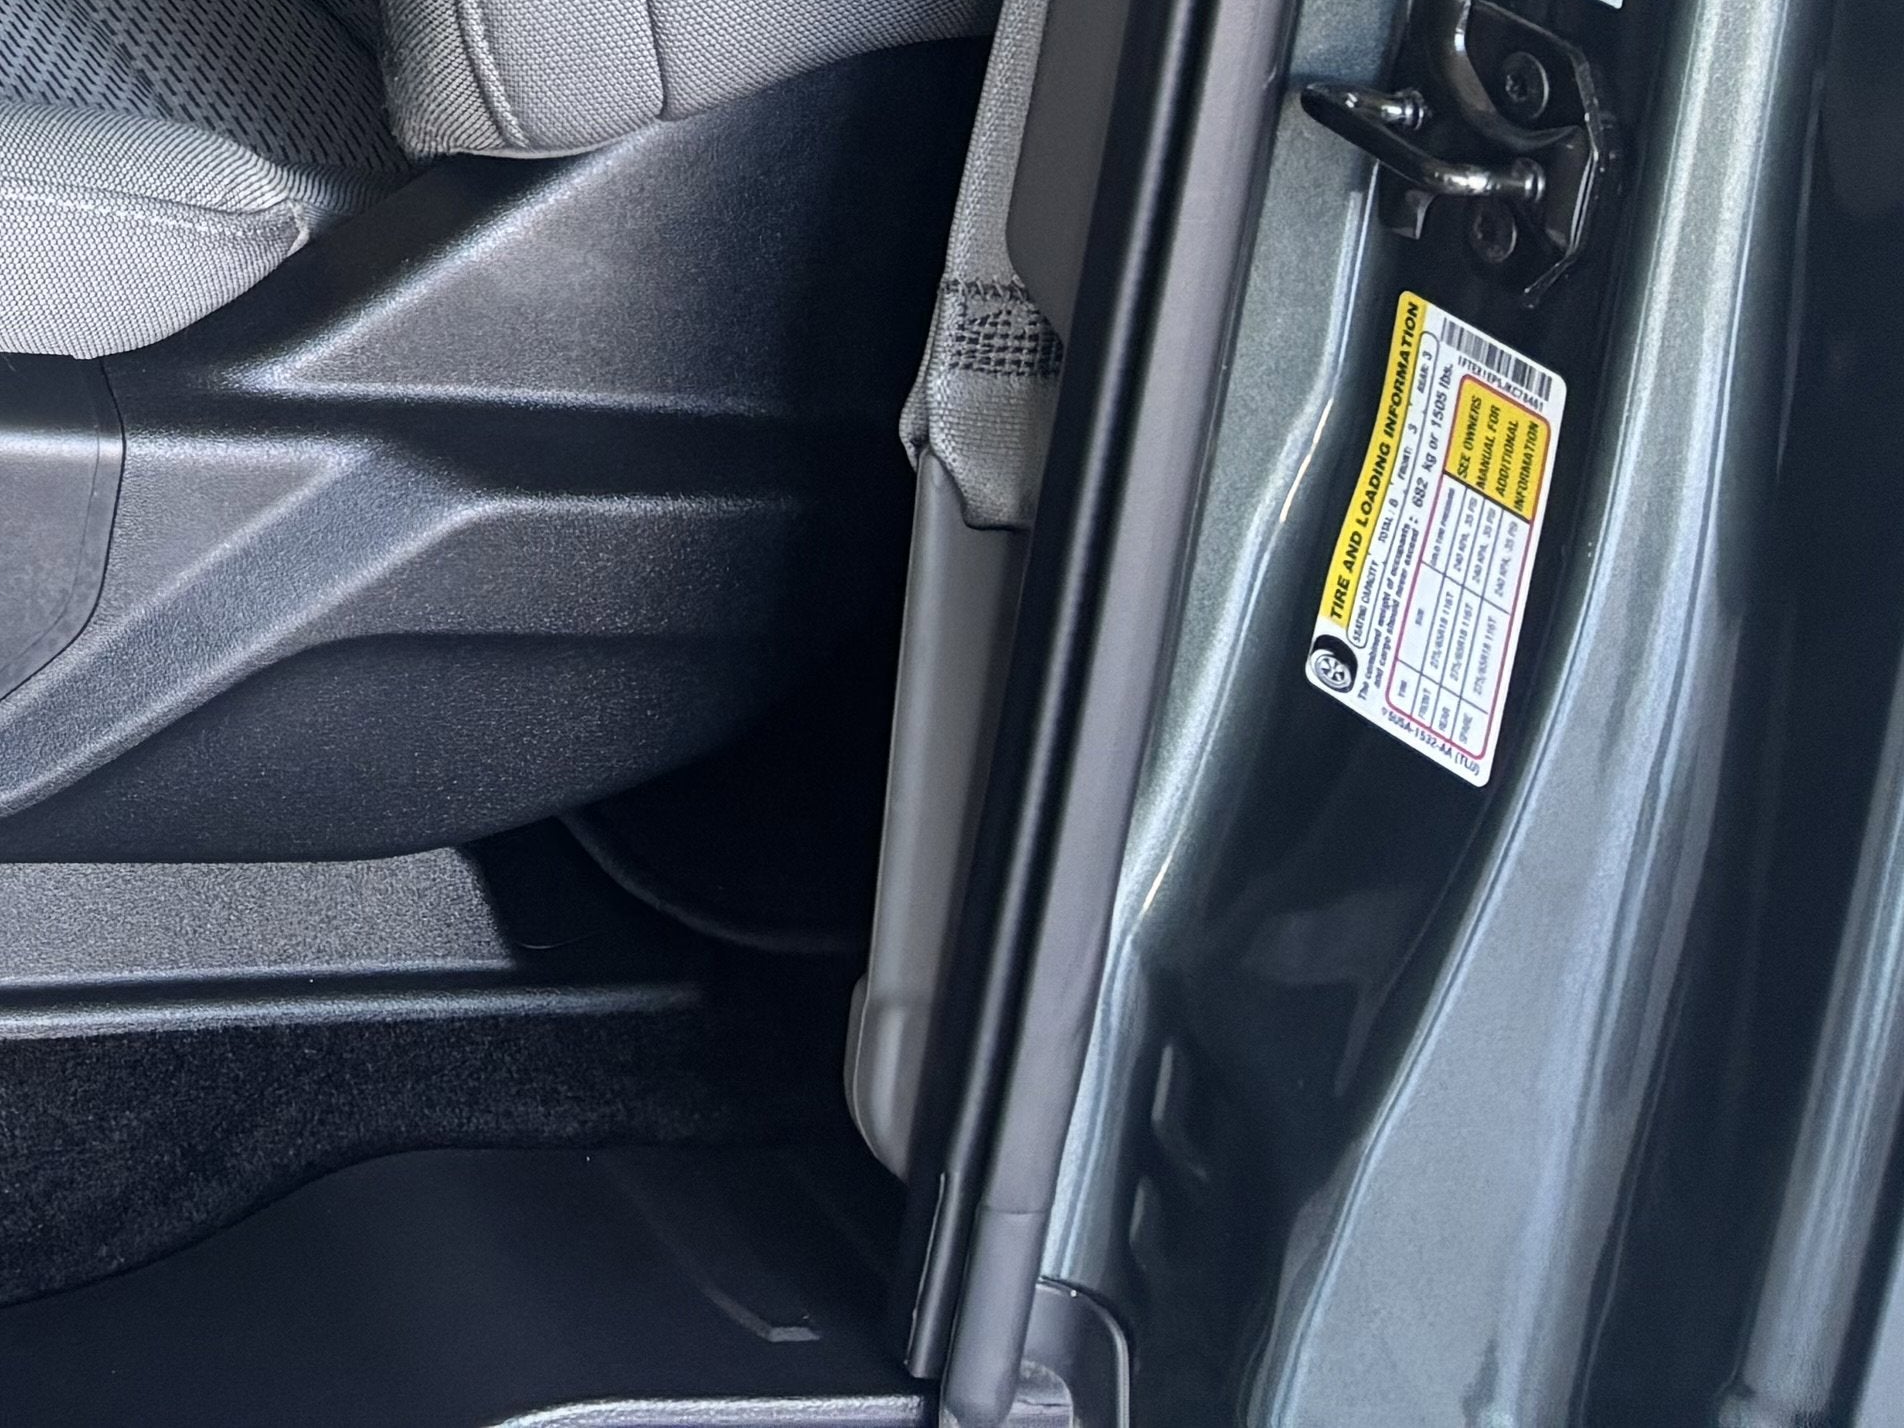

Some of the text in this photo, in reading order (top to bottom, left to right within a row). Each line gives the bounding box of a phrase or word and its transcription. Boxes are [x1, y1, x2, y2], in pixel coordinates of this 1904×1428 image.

[1329, 300, 1418, 621] TIRE AND LOADING INFORMATION
[1412, 359, 1453, 509] 682 kg or 1505 lbs.
[1456, 393, 1482, 479] SEE OWNERS
[1474, 404, 1501, 490] MANUAL FOR
[1494, 416, 1519, 497] ADDITIONAL
[1510, 419, 1540, 512] INFORMATION
[1358, 520, 1410, 701] The combined weight of occupants
[1385, 598, 1400, 635] should
[1395, 566, 1408, 598] never
[1372, 666, 1384, 689] and
[1378, 636, 1393, 668] cargo
